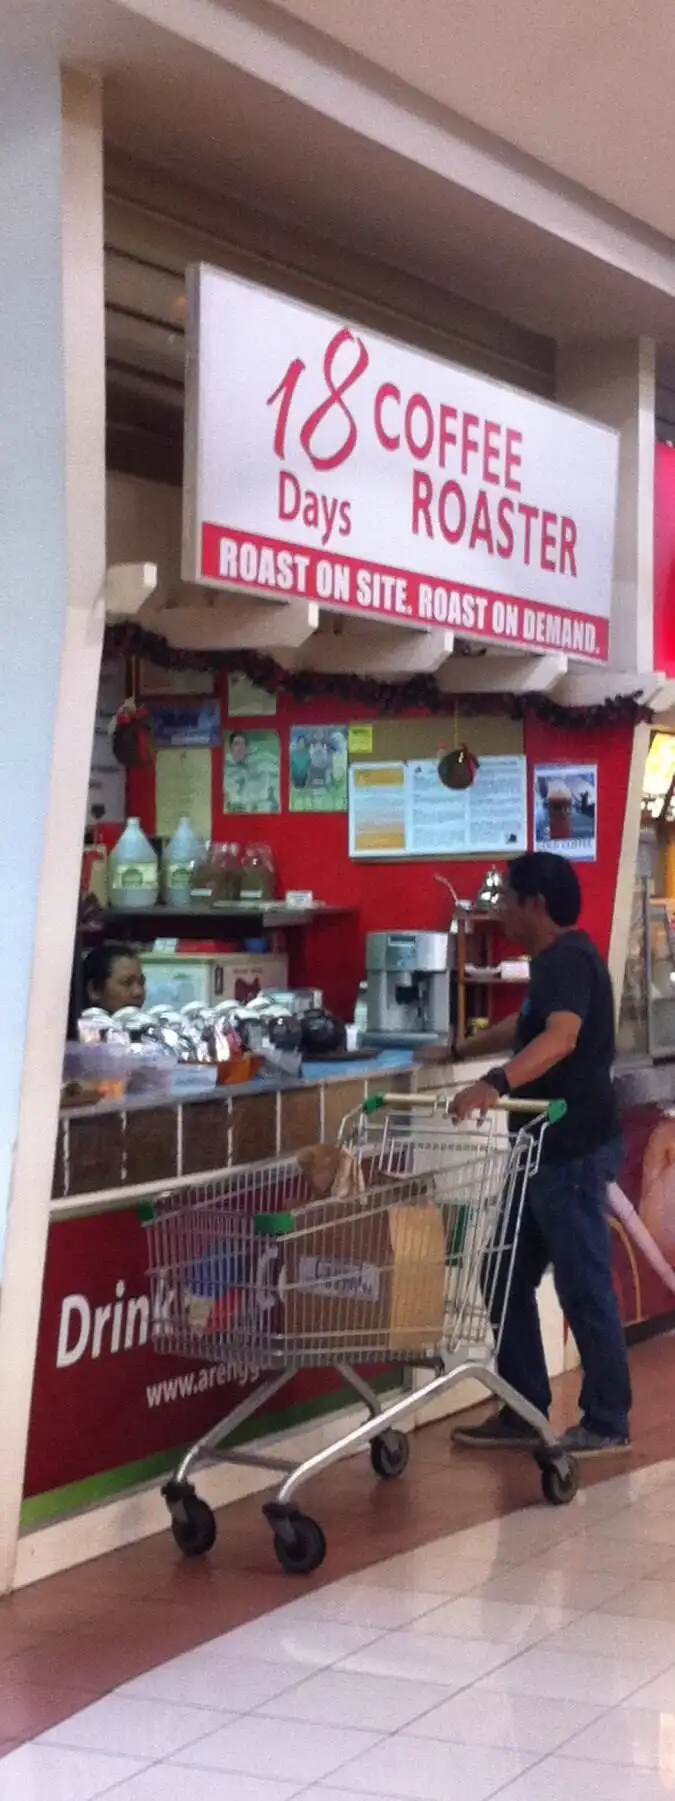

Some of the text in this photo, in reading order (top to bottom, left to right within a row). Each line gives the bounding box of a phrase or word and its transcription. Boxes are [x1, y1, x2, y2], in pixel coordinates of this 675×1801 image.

[266, 327, 369, 470] 18
[374, 382, 523, 492] COFFEE
[277, 470, 352, 545] Days
[411, 469, 578, 577] ROASTER
[219, 537, 600, 654] ROAST ON SITE. ROAST ON DEMAND.
